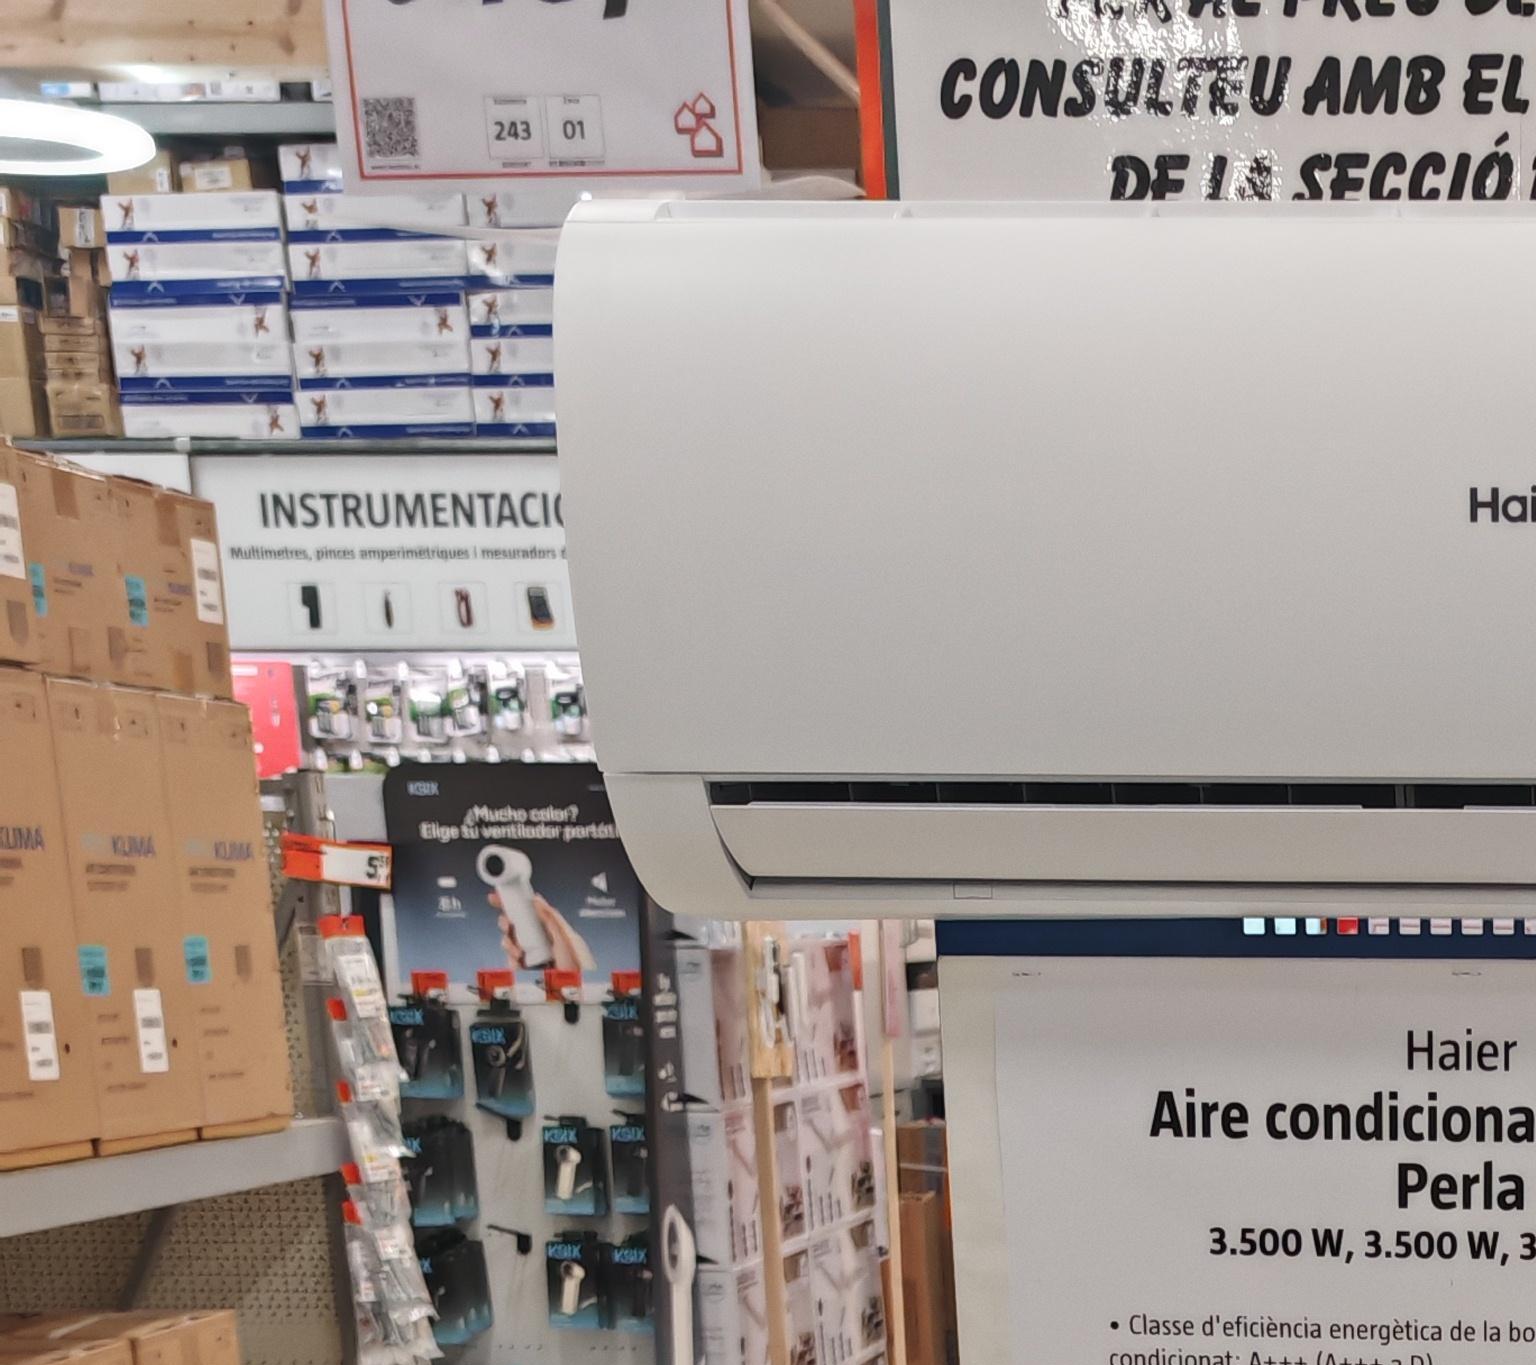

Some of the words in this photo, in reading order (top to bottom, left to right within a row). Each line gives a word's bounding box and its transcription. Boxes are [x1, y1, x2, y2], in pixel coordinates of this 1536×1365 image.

[940, 55, 1292, 121] CONSULTEU
[1302, 55, 1446, 116] AMB
[1463, 53, 1530, 115] EL
[494, 120, 531, 141] 243
[562, 119, 585, 141] 01
[1110, 153, 1191, 200] DE
[1293, 132, 1517, 200] SECCIÓ
[1406, 1027, 1518, 1072] Haier
[1148, 1087, 1250, 1140] Aire
[1397, 1159, 1525, 1212] Perla
[1208, 1226, 1303, 1258] 3.500
[1310, 1227, 1355, 1265] W,
[1364, 1229, 1458, 1260] 3.500
[1466, 1230, 1510, 1267] W,
[1128, 1313, 1195, 1337] Classe
[1201, 1314, 1322, 1340] d'eficiència
[1329, 1318, 1443, 1347] energètica
[1449, 1319, 1476, 1343] de
[1483, 1319, 1501, 1343] la
